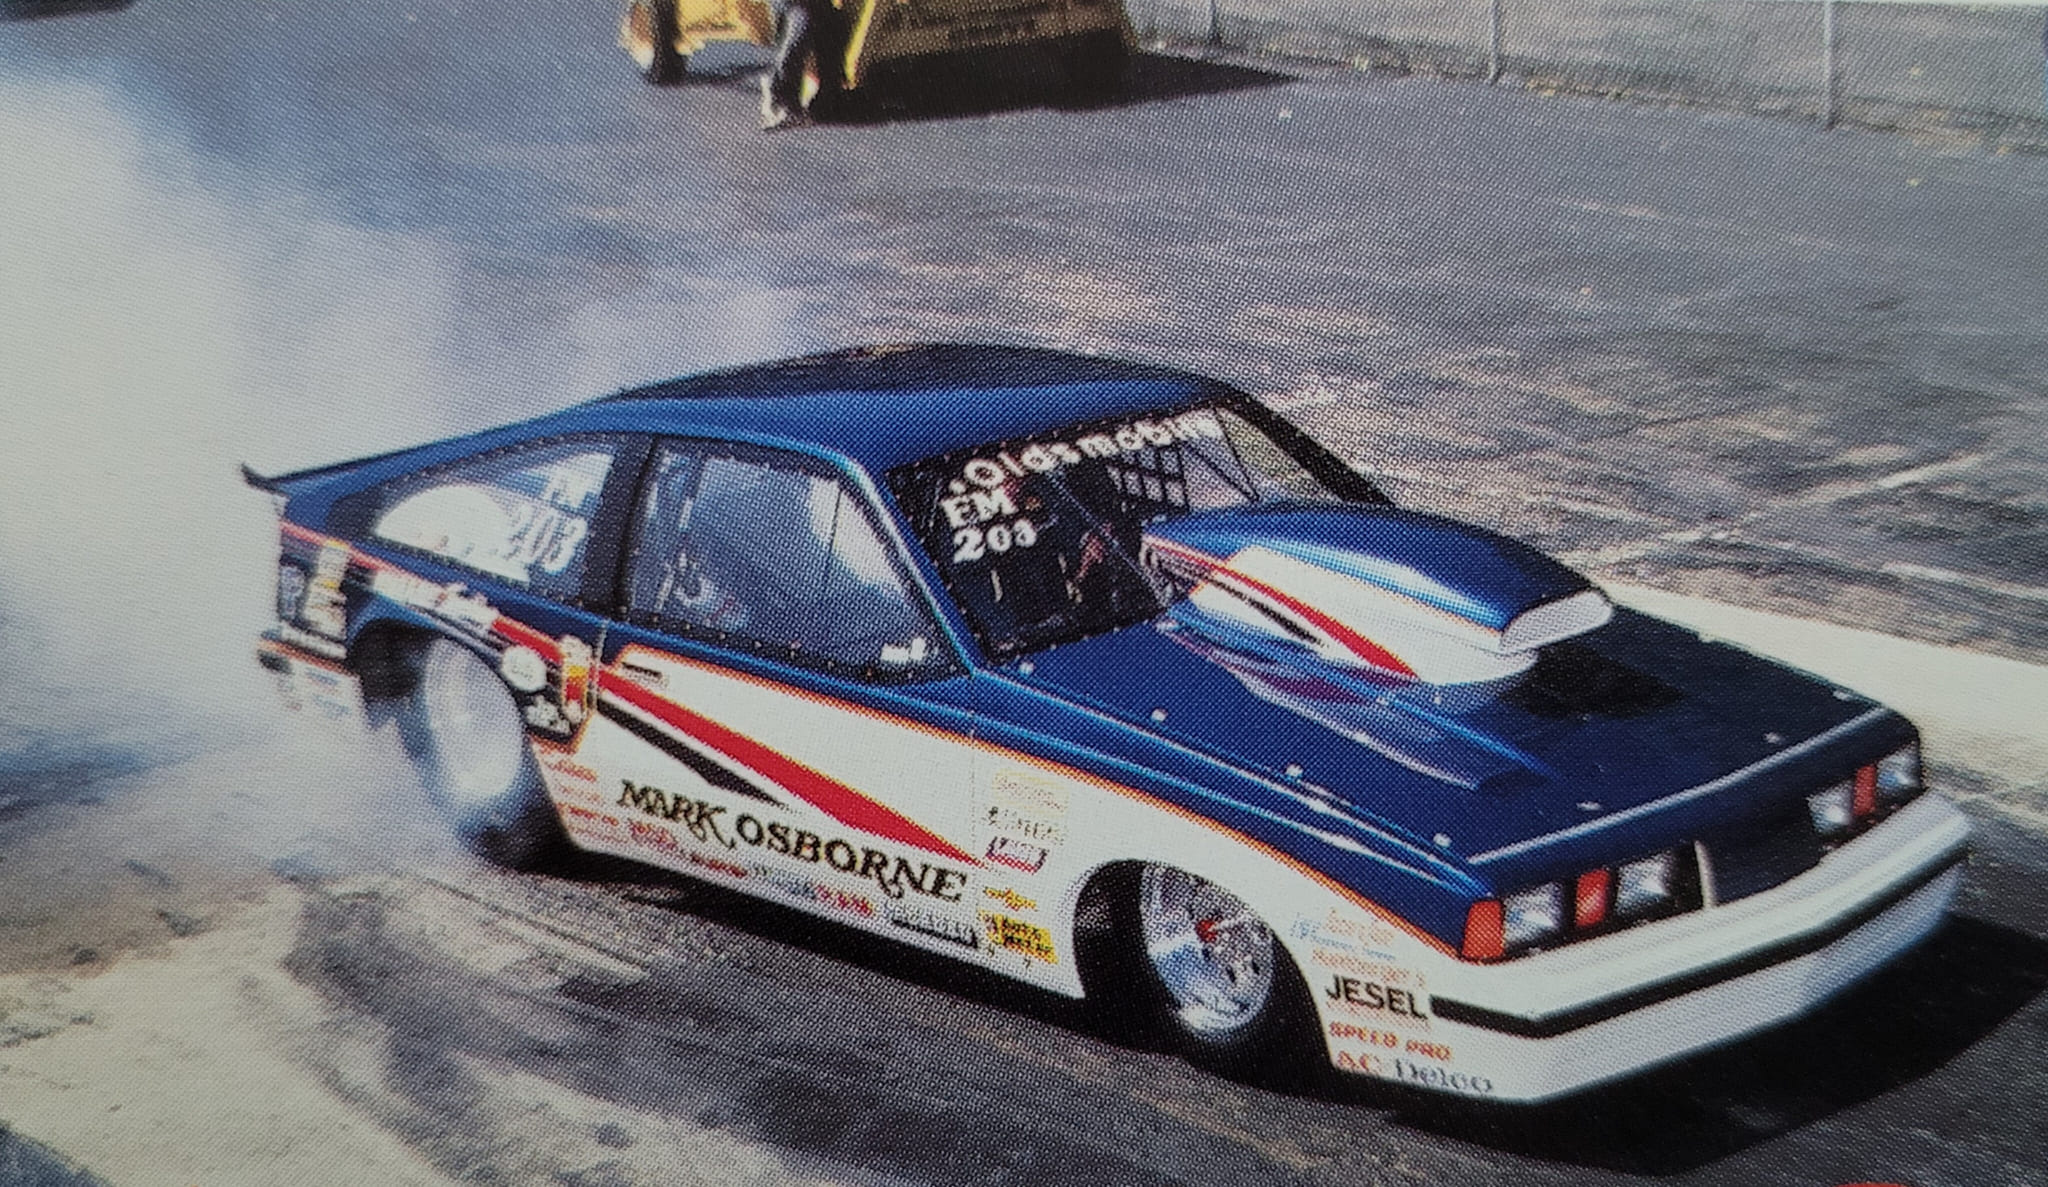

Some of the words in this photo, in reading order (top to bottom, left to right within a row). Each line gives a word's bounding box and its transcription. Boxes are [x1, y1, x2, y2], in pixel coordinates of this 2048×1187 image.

[940, 488, 1017, 528] EM
[953, 518, 1037, 563] 203
[616, 780, 738, 849] MARK
[735, 813, 967, 903] OSBORNE
[1325, 973, 1428, 1020] JESEL
[1328, 1021, 1398, 1049] SPEED
[1405, 1039, 1452, 1062] PRO
[1336, 1051, 1383, 1072] AC
[1396, 1058, 1493, 1092] Delco
